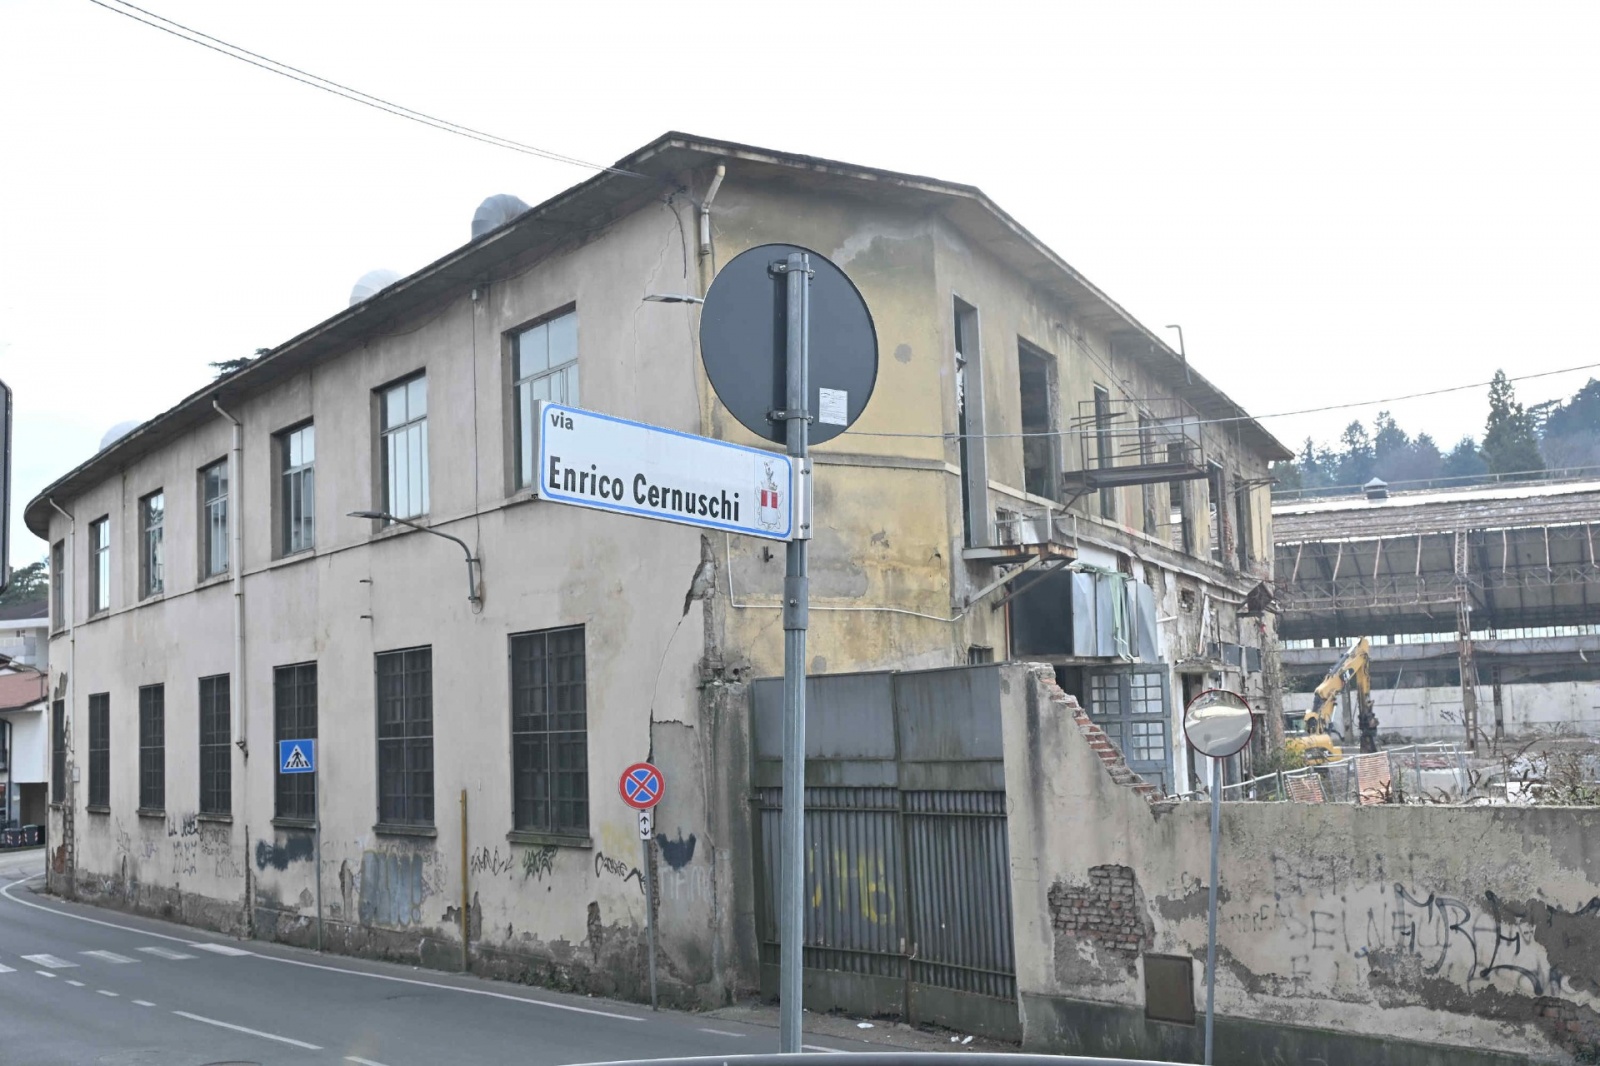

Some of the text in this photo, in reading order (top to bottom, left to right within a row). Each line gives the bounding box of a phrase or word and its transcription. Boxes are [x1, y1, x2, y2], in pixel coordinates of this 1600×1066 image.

[551, 413, 573, 430] via
[549, 455, 739, 521] Enrico Cernuschi
